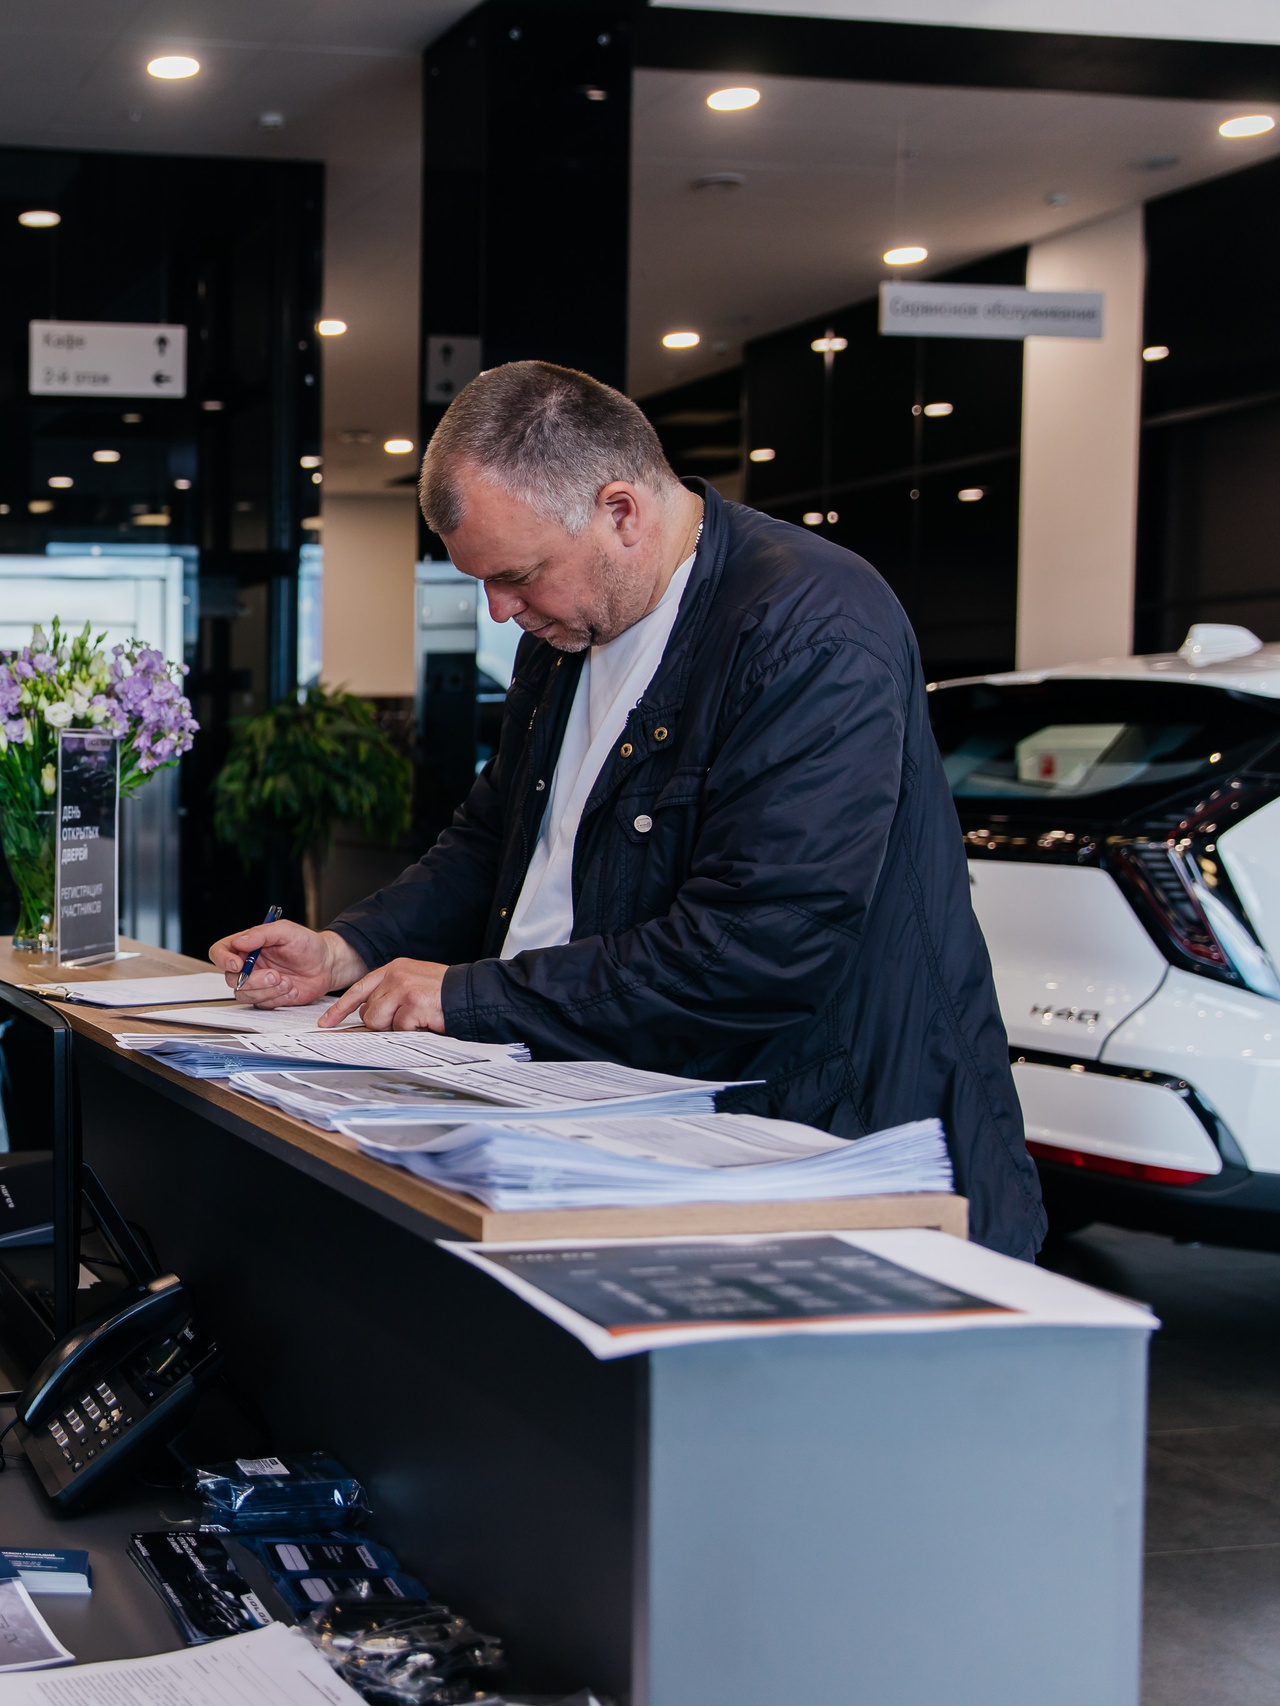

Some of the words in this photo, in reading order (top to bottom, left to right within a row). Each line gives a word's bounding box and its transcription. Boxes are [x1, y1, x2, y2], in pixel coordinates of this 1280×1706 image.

[62, 805, 81, 822] ДЕНЬ
[62, 826, 100, 841] ОТКРЫТЫХ
[61, 843, 88, 865] ДВЕРЕЙ
[61, 883, 103, 900] РЕГИСТРАЦИЯ
[61, 901, 102, 918] УЧАСТНИКОВ
[246, 1595, 270, 1624] VOLGA
